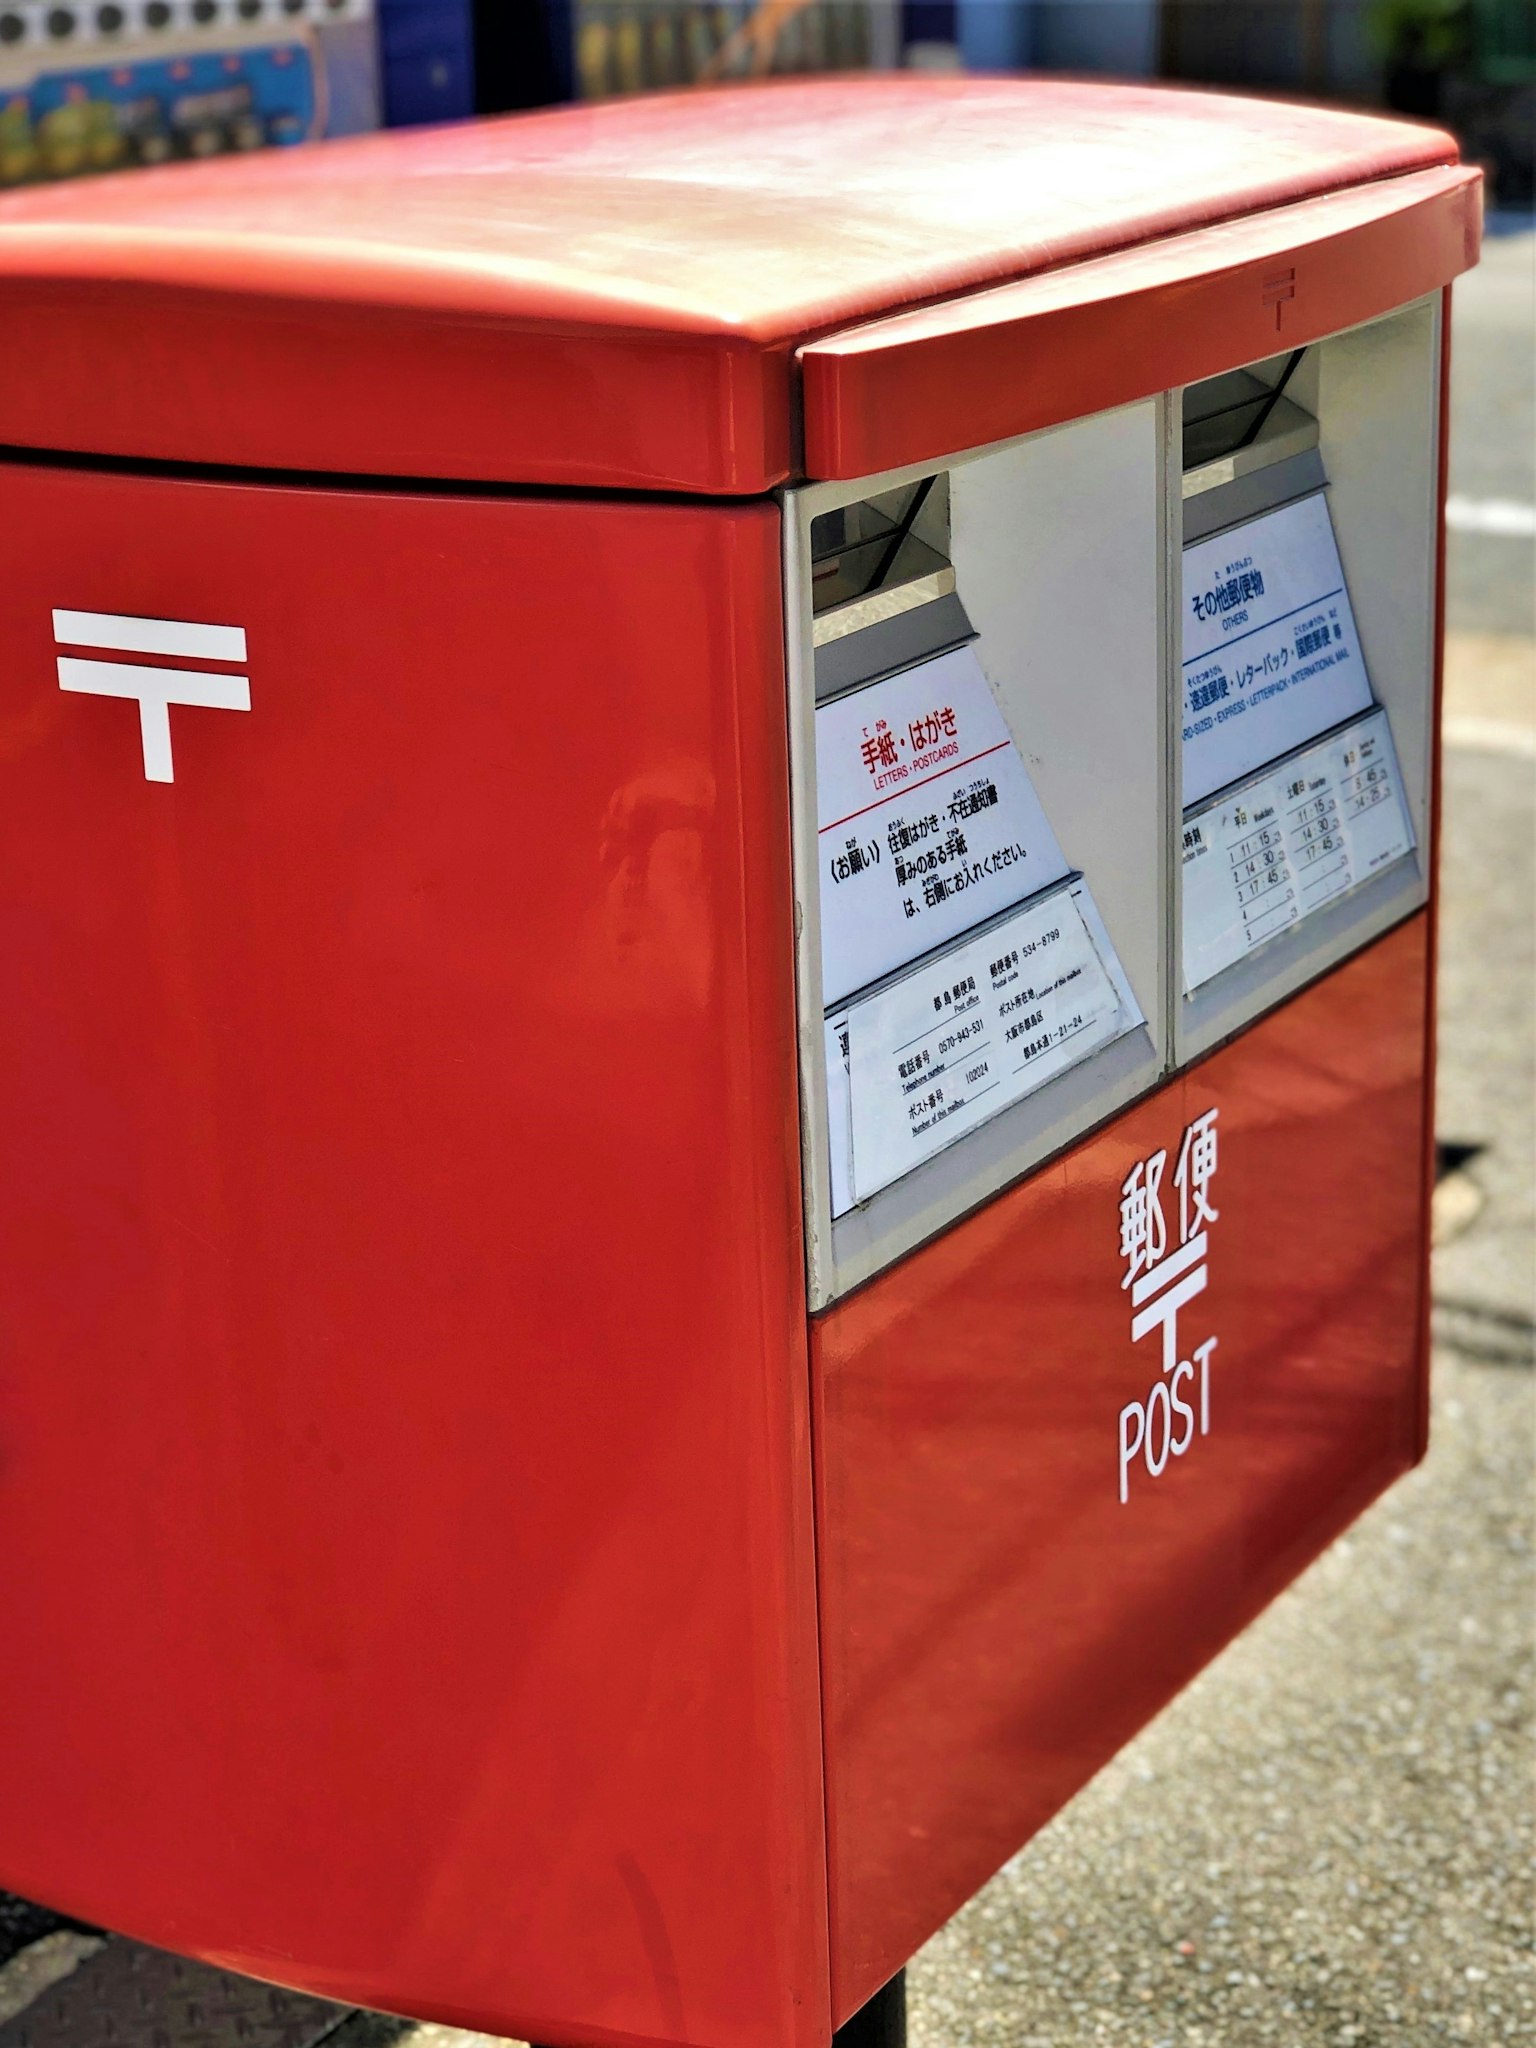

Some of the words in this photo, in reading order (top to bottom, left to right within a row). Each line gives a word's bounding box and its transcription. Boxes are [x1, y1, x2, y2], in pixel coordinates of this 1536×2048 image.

[1192, 568, 1265, 621] その他郵便物
[1222, 609, 1249, 631] OTHERS
[860, 707, 957, 774] 手紙・はがき
[895, 833, 968, 888] 厚みのある手紙
[1182, 825, 1202, 850] 時刻
[903, 843, 1027, 919] は、右側にお入れください。
[990, 951, 1019, 979] 郵便番号
[1022, 928, 1060, 958] 534-8799
[954, 1003, 967, 1014] Post
[966, 995, 980, 1007] office
[992, 976, 1008, 991] Postal
[898, 1049, 931, 1079] 電話番号
[938, 1019, 984, 1055] 0570-943-531
[1004, 1009, 1044, 1043] 大阪市都島区
[908, 1088, 944, 1120] ポスト番号
[965, 1061, 989, 1084] 102024
[912, 1117, 931, 1135] Number
[1119, 1107, 1219, 1290] 郵便
[1119, 1336, 1219, 1505] POST
